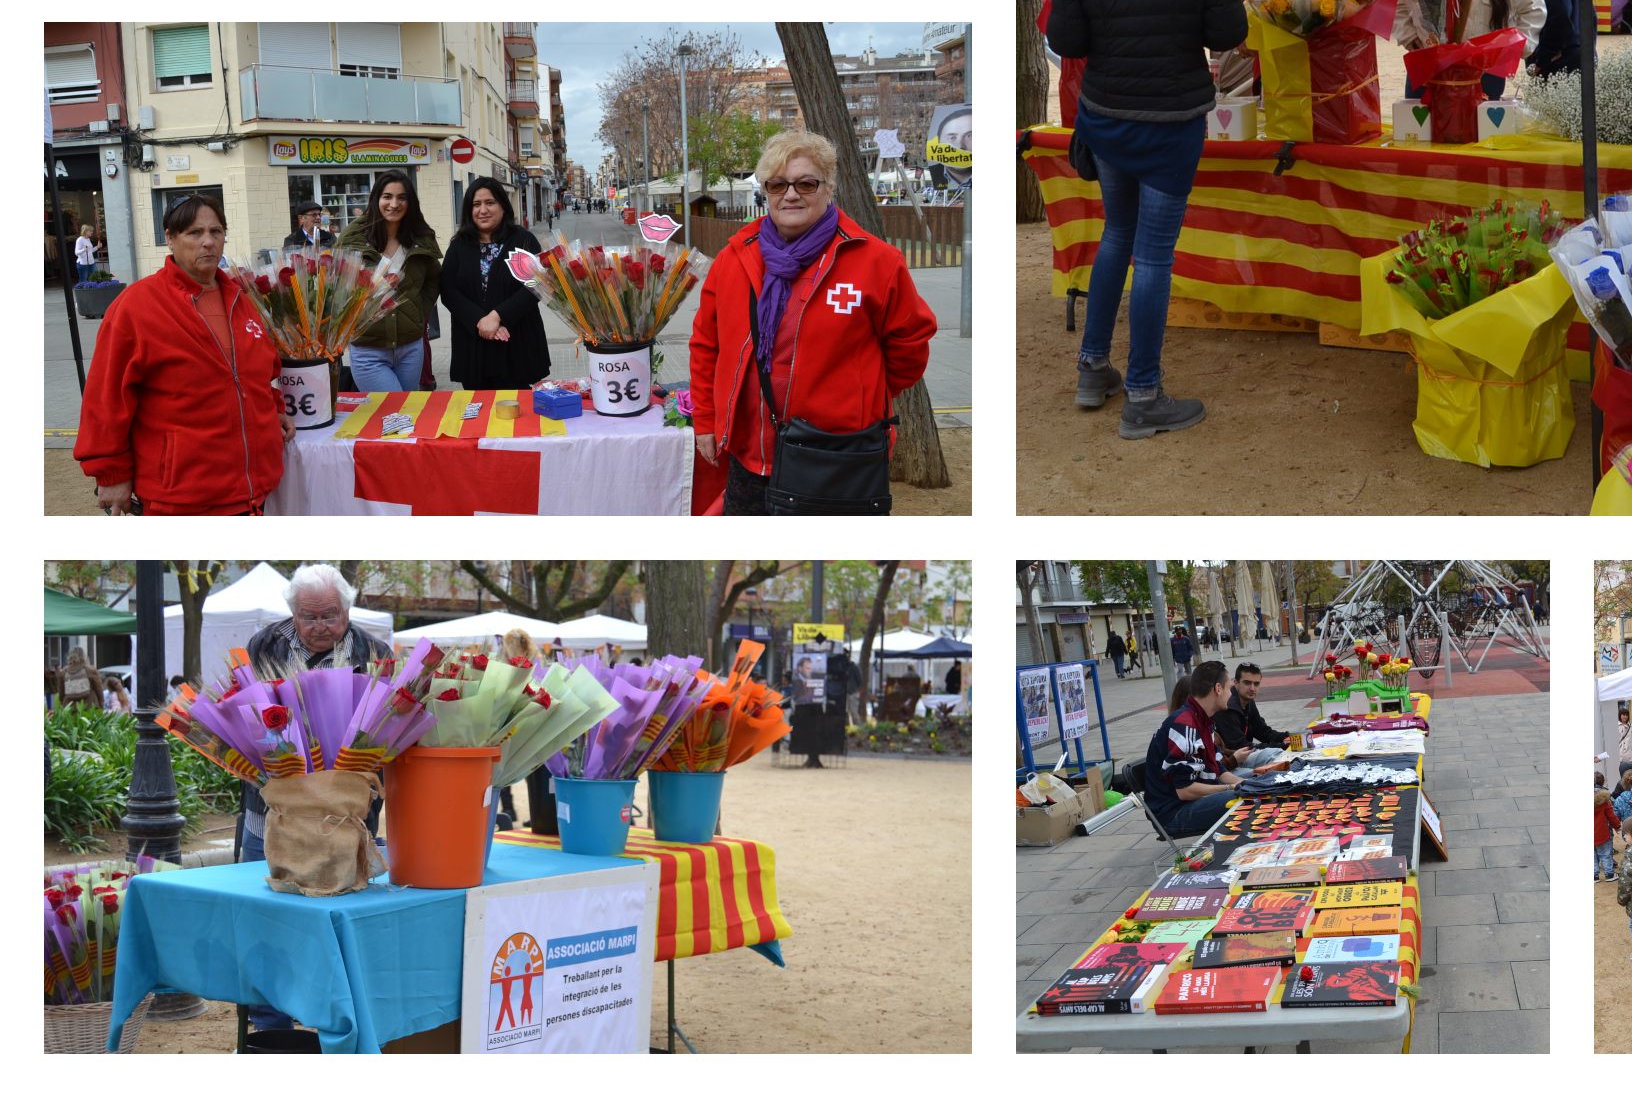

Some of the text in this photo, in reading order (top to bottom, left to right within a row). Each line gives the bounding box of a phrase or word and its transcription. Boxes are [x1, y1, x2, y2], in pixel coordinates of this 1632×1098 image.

[299, 138, 349, 163] IRIS
[351, 154, 408, 163] LLAMINADURES
[930, 145, 943, 153] Va
[598, 361, 630, 372] ROSA
[607, 378, 640, 403] 3€
[283, 393, 317, 417] 3€
[493, 935, 543, 975] MARPI
[547, 933, 636, 960] ASSOCIACIÓ MARPI
[562, 965, 623, 984] Treballant per la
[562, 982, 622, 1003] integració de les
[1178, 973, 1192, 1001] PANRICO
[546, 997, 633, 1027] persones discapacitades
[1059, 1005, 1073, 1013] ANYS
[1074, 1005, 1086, 1013] DELS
[1087, 1005, 1098, 1013] CAP
[523, 1027, 541, 1038] MARPI
